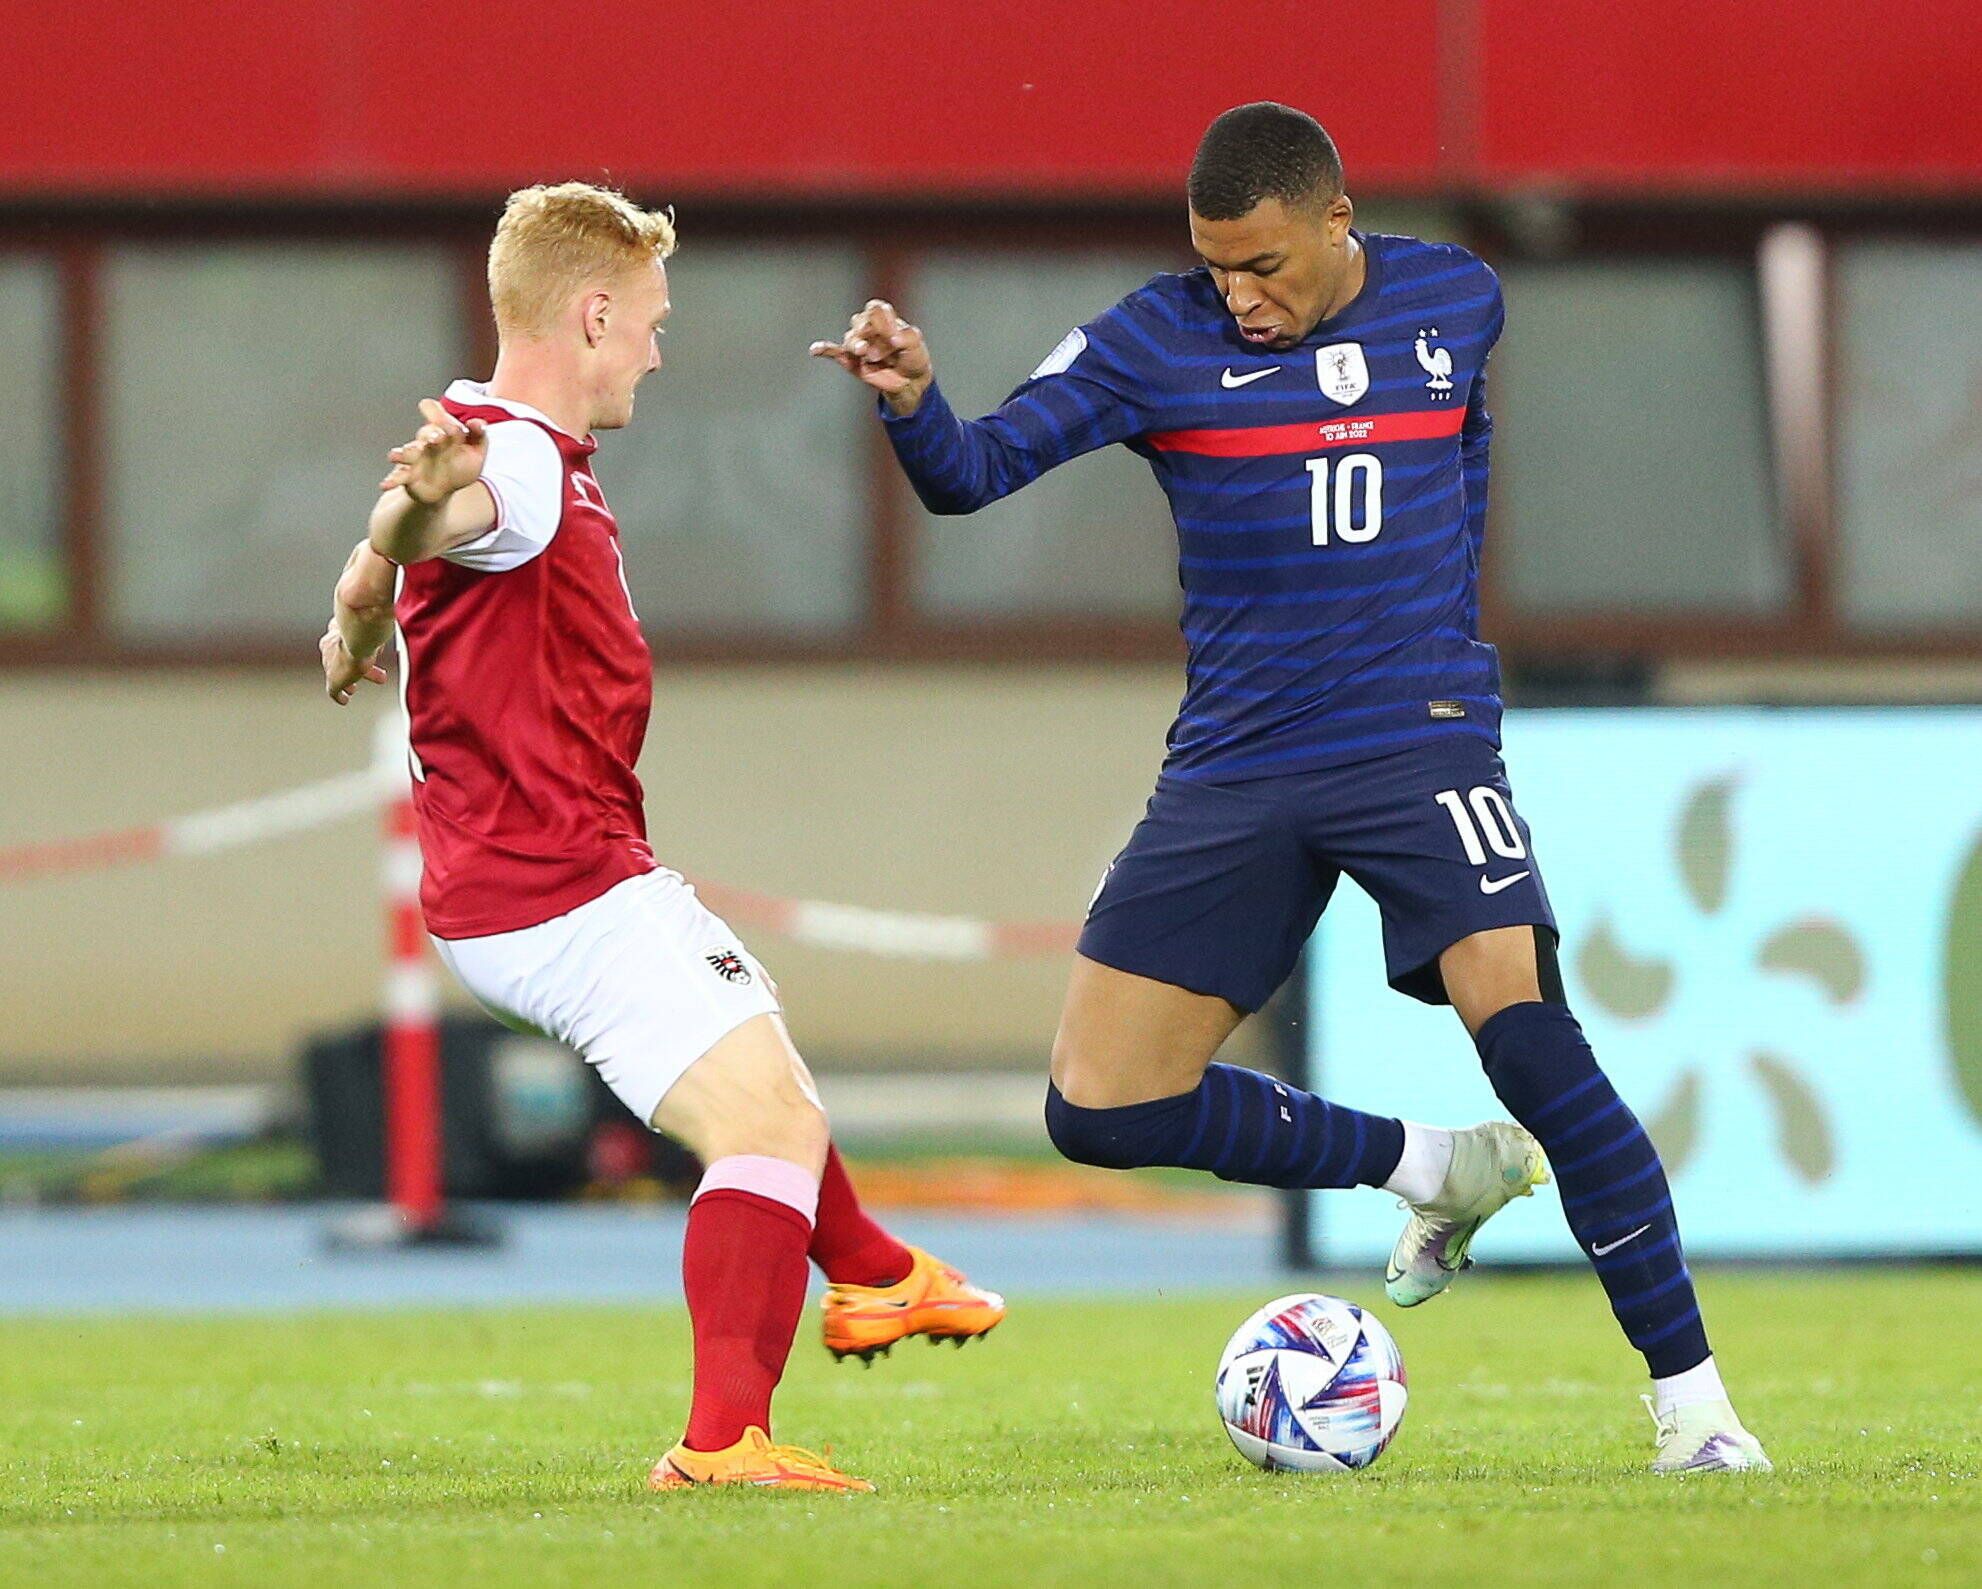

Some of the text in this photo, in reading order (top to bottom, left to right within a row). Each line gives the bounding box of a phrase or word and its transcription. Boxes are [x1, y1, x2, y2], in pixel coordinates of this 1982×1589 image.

[1325, 432, 1334, 441] 10
[1348, 429, 1368, 438] 2022
[1351, 421, 1374, 430] FRANCE
[1305, 453, 1382, 546] 10
[1434, 786, 1527, 866] 10
